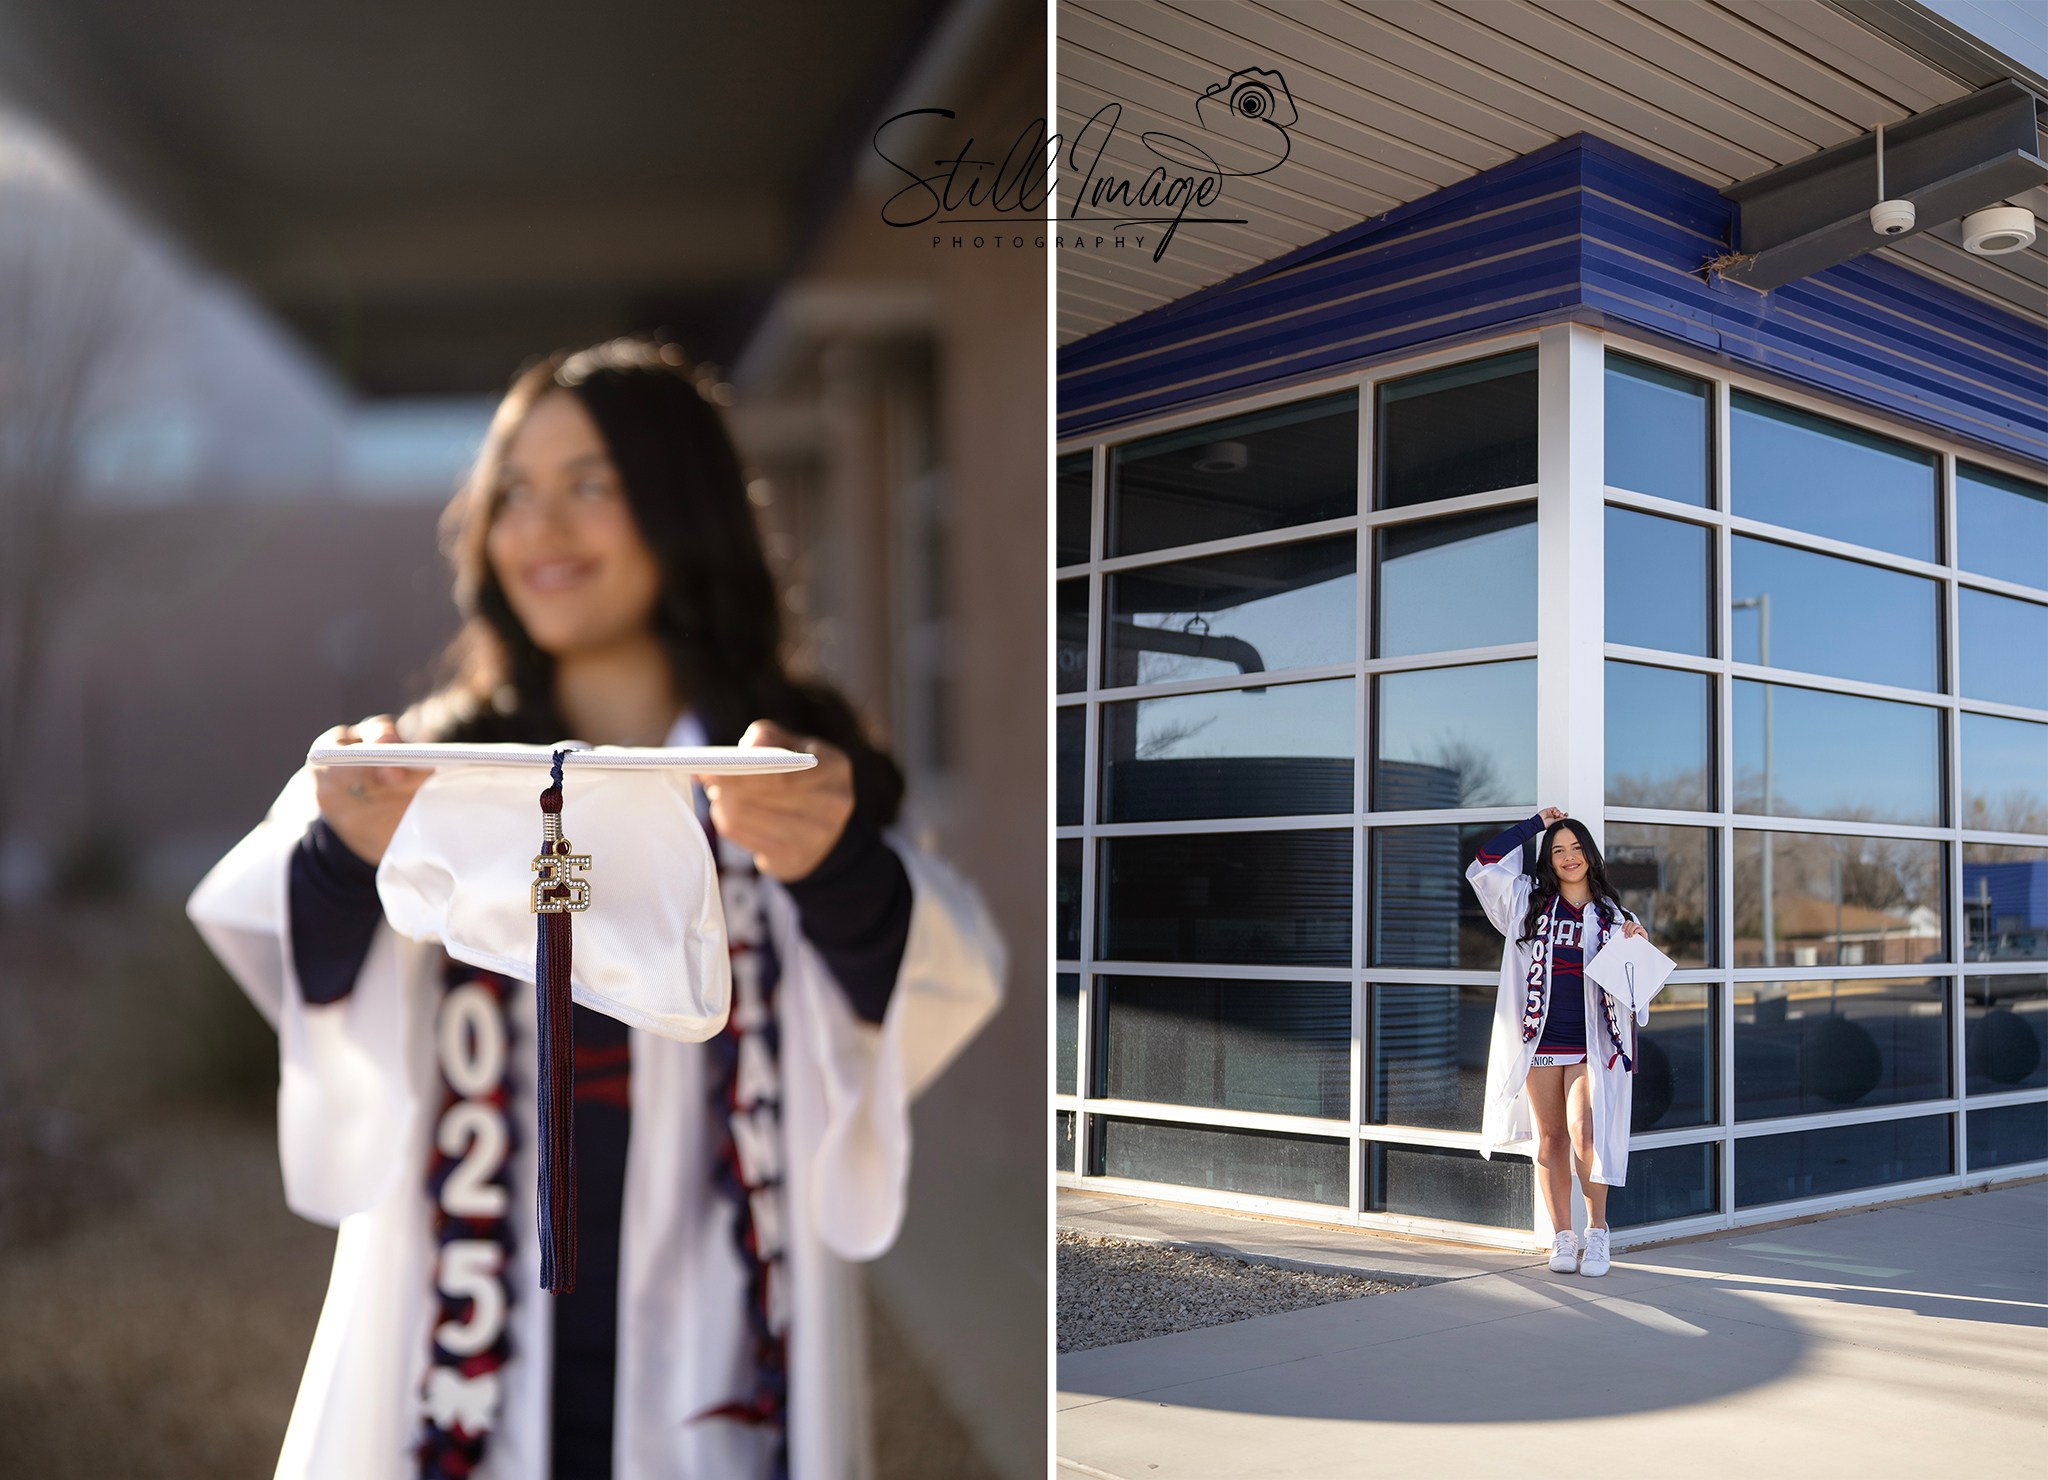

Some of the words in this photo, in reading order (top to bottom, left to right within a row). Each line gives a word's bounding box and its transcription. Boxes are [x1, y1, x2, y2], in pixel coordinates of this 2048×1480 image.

[530, 854, 593, 914] 25
[1528, 914, 1549, 1013] 2025
[1530, 1056, 1554, 1067] NIOR
